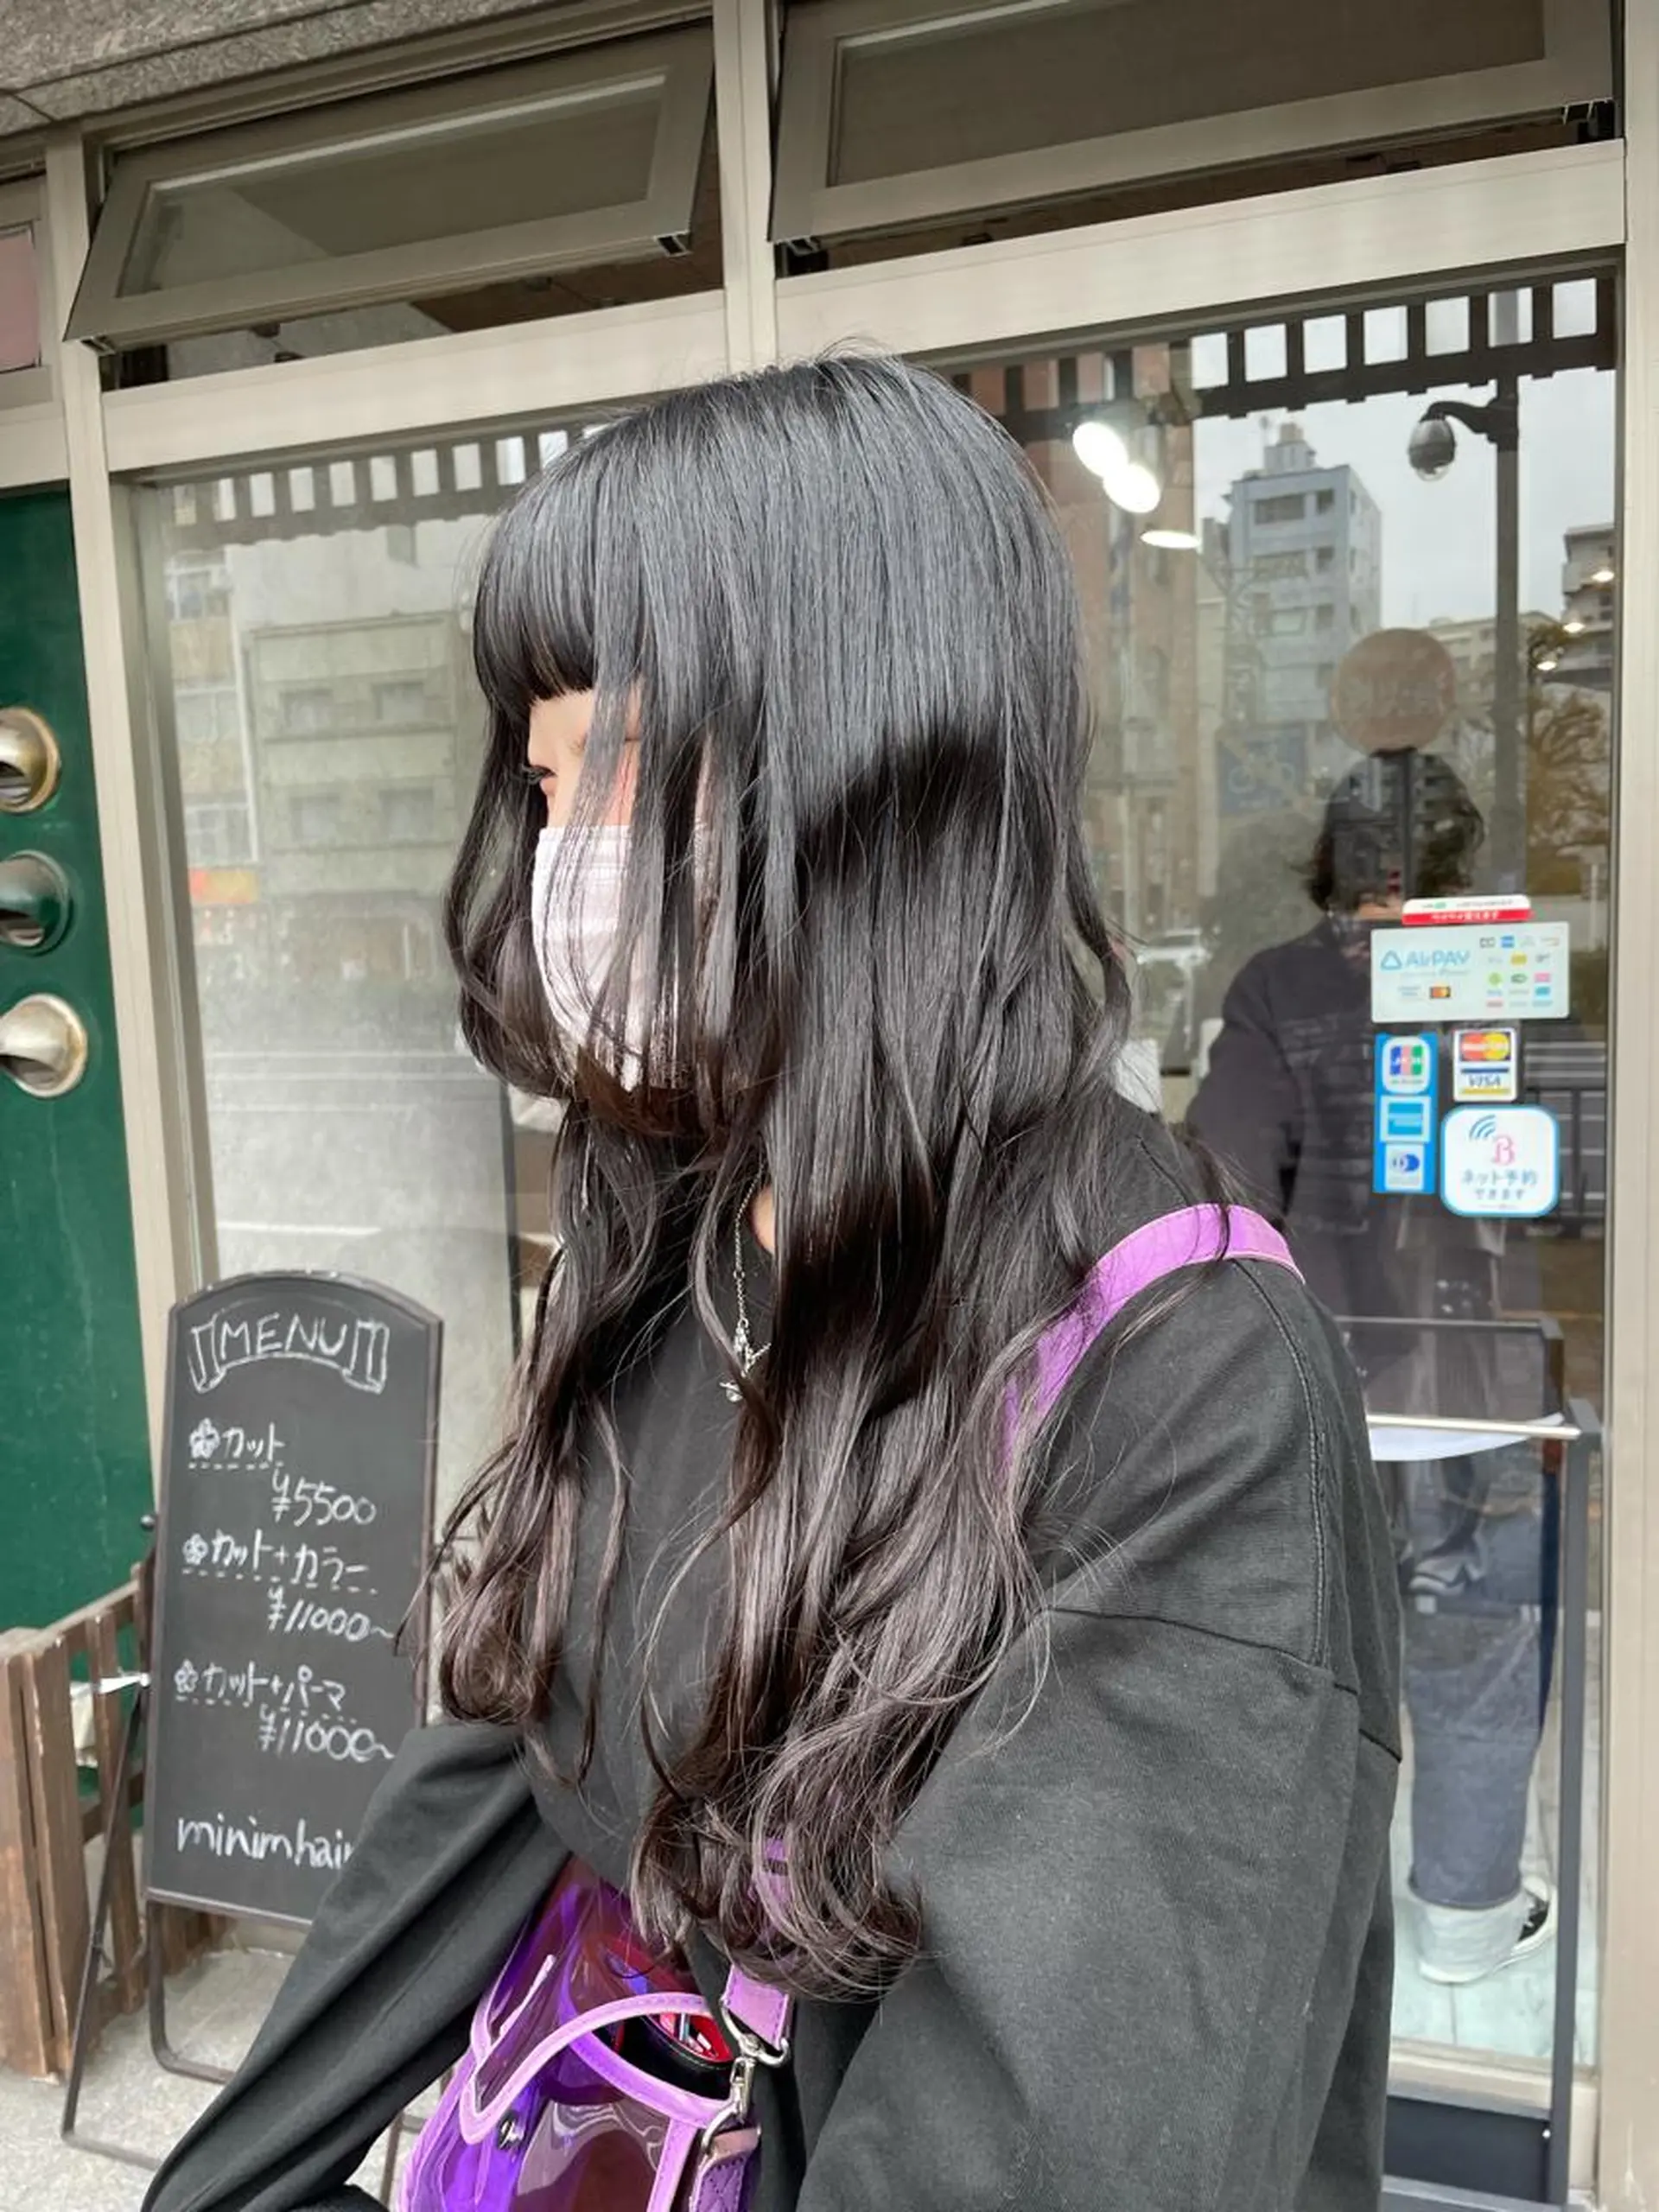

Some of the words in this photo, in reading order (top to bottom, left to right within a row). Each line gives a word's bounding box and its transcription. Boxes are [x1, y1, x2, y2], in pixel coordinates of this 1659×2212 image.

[1468, 1073, 1502, 1087] VISA
[1461, 1168, 1538, 1185] ネット予約
[219, 1312, 348, 1361] MENU
[221, 1421, 286, 1462] カット
[270, 1466, 378, 1527] ¥5500
